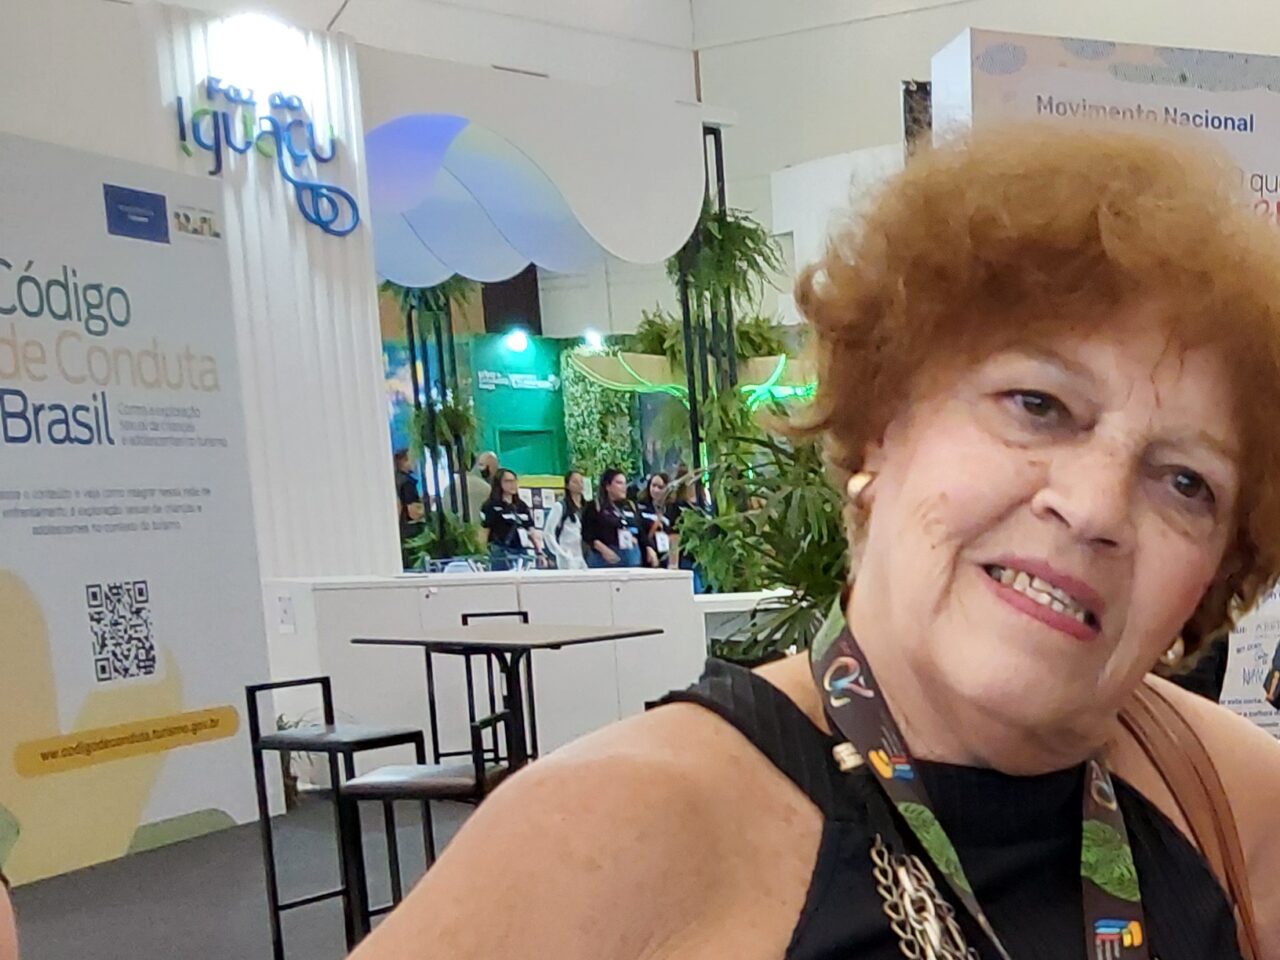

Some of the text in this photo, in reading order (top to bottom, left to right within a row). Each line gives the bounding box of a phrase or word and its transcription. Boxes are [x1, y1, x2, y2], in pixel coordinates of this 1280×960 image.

[1163, 105, 1255, 132] Nacional
[0, 322, 220, 392] de Conduta
[0, 387, 115, 445] Brasil
